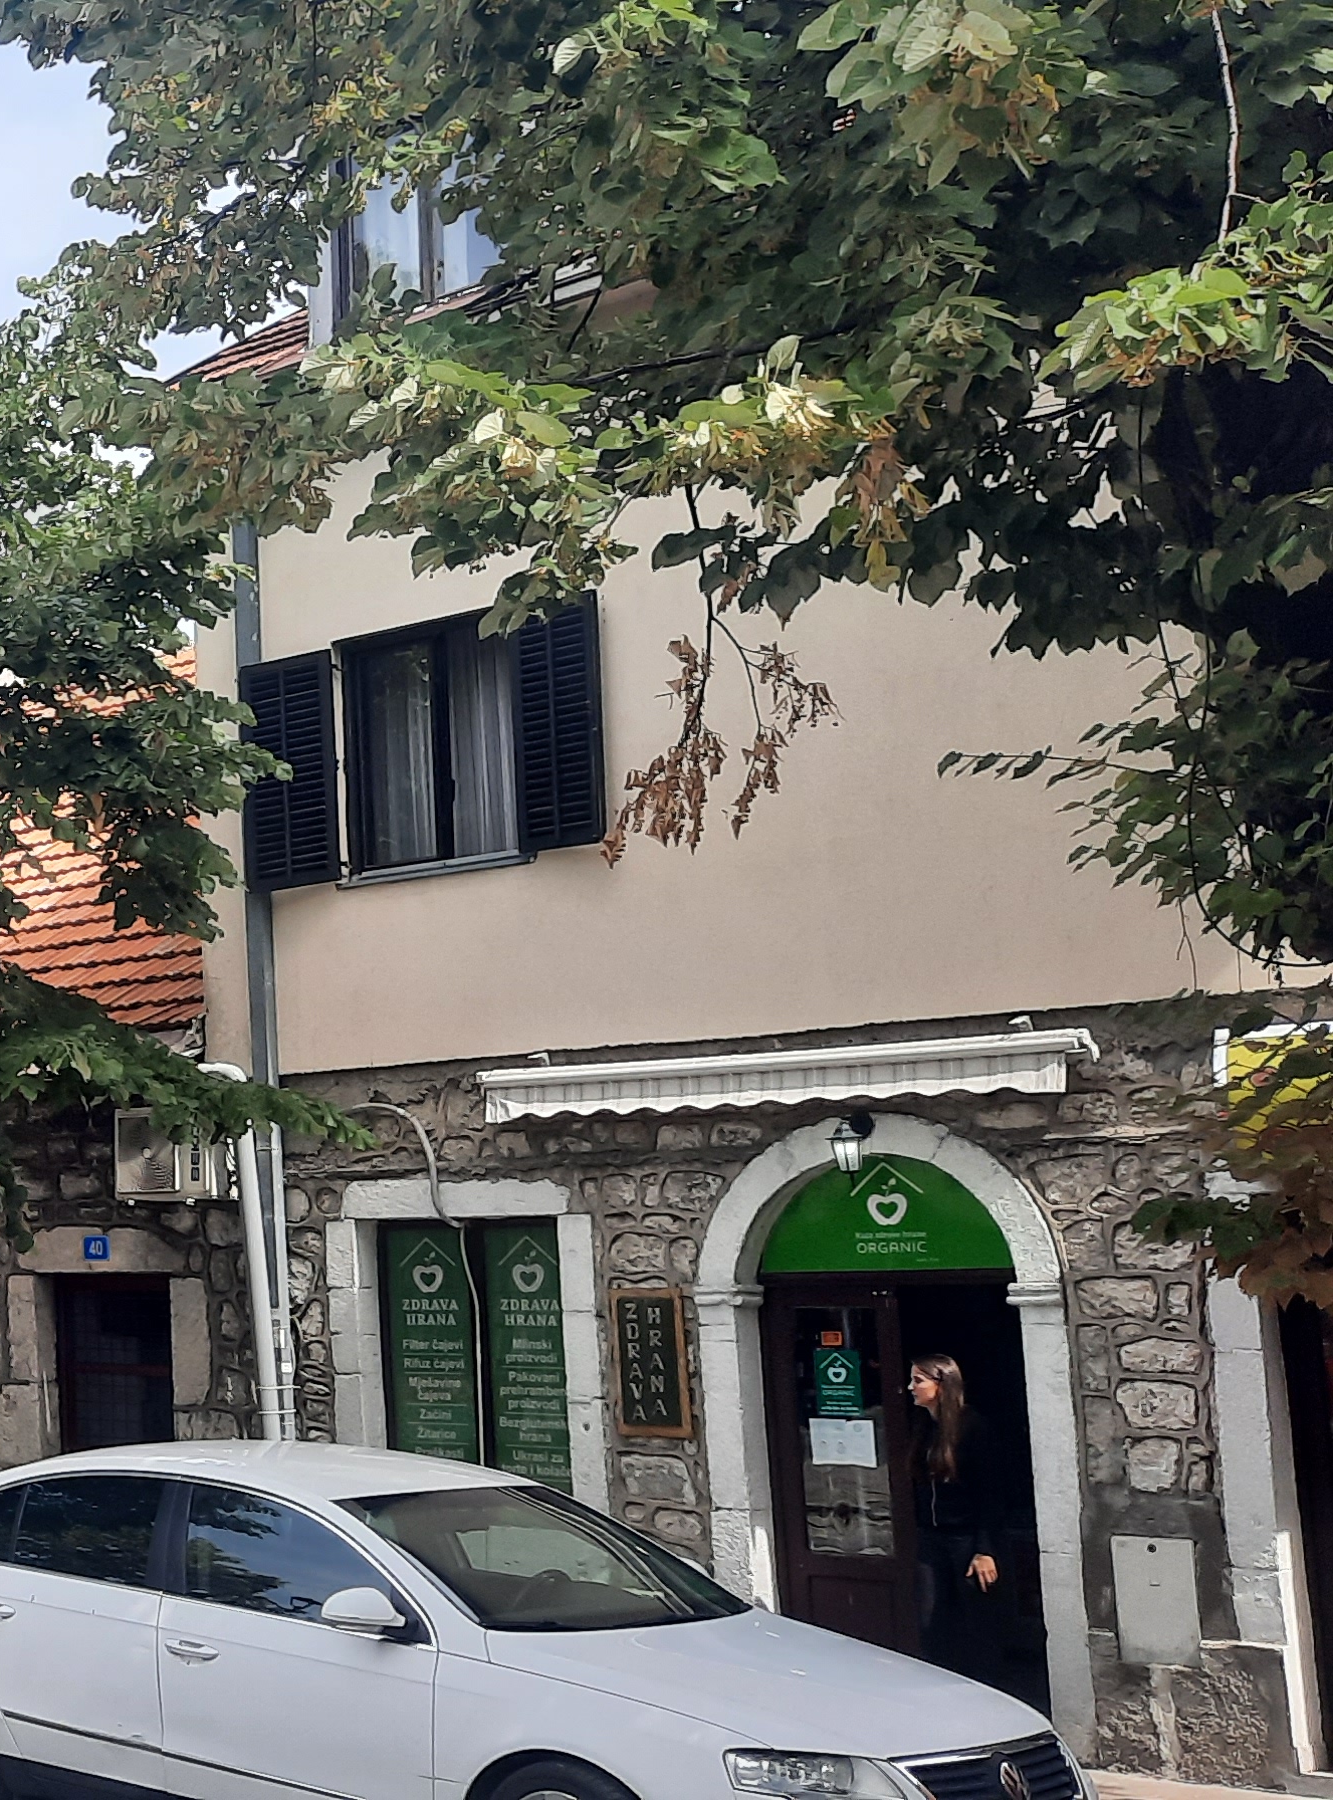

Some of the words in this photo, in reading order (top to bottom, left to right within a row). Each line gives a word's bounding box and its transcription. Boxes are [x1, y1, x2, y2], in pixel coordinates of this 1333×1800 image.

[88, 1240, 103, 1256] 40
[856, 1241, 928, 1254] ORGANIC
[402, 1299, 459, 1311] ZDRAVA
[500, 1299, 560, 1311] ZDRAVA
[406, 1313, 457, 1326] HRANA
[504, 1314, 558, 1327] HRANA
[402, 1338, 429, 1350] Filter
[512, 1338, 552, 1350] Mlinski
[505, 1352, 558, 1364] proizvodi
[624, 1302, 648, 1422] ZDRAVA
[646, 1306, 668, 1417] HRANA
[508, 1371, 560, 1383] Pakovani
[499, 1384, 567, 1397] prehramben
[499, 1416, 567, 1430] Bezglutensk
